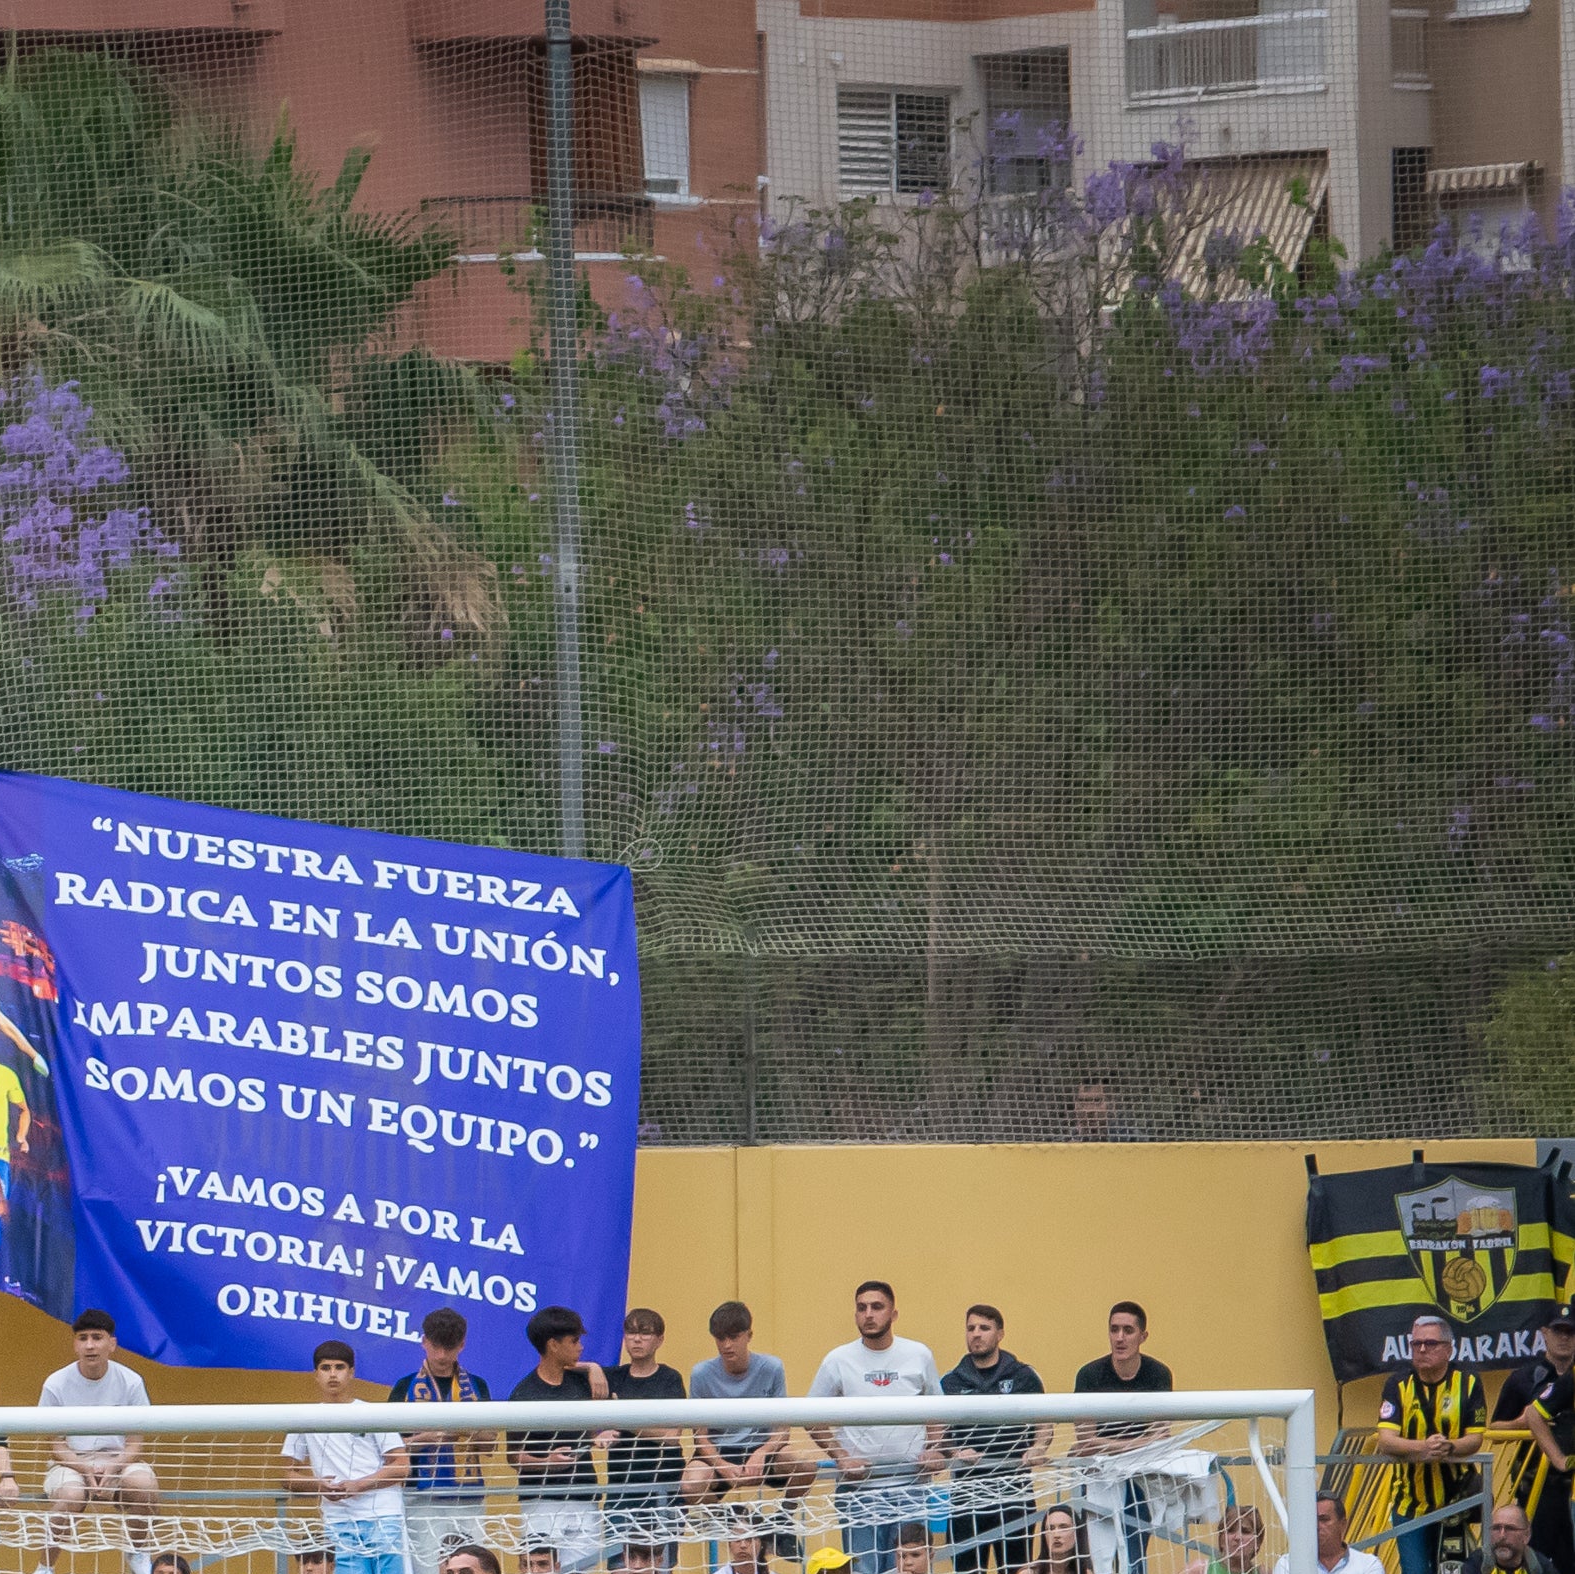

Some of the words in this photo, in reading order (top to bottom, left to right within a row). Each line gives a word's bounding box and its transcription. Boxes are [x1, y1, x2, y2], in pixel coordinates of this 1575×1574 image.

[373, 859, 581, 918] FUERZA
[54, 871, 259, 928] RADICA
[269, 899, 341, 939] EN
[353, 911, 423, 950] LA
[431, 922, 620, 986] UNIÓN,
[138, 941, 344, 998] JUNTOS
[355, 970, 539, 1028] SOMOS
[84, 1056, 267, 1113] SOMOS
[277, 1083, 357, 1128] UN
[412, 1040, 613, 1107] JUNTOS
[155, 1165, 326, 1218] ¡VAMOS
[333, 1192, 366, 1226] A
[373, 1198, 462, 1243] POR
[468, 1215, 525, 1256] LA
[134, 1219, 366, 1278] VICTORIA!
[374, 1253, 538, 1313] ¡VAMOS
[216, 1283, 426, 1344] ORIHUEL
